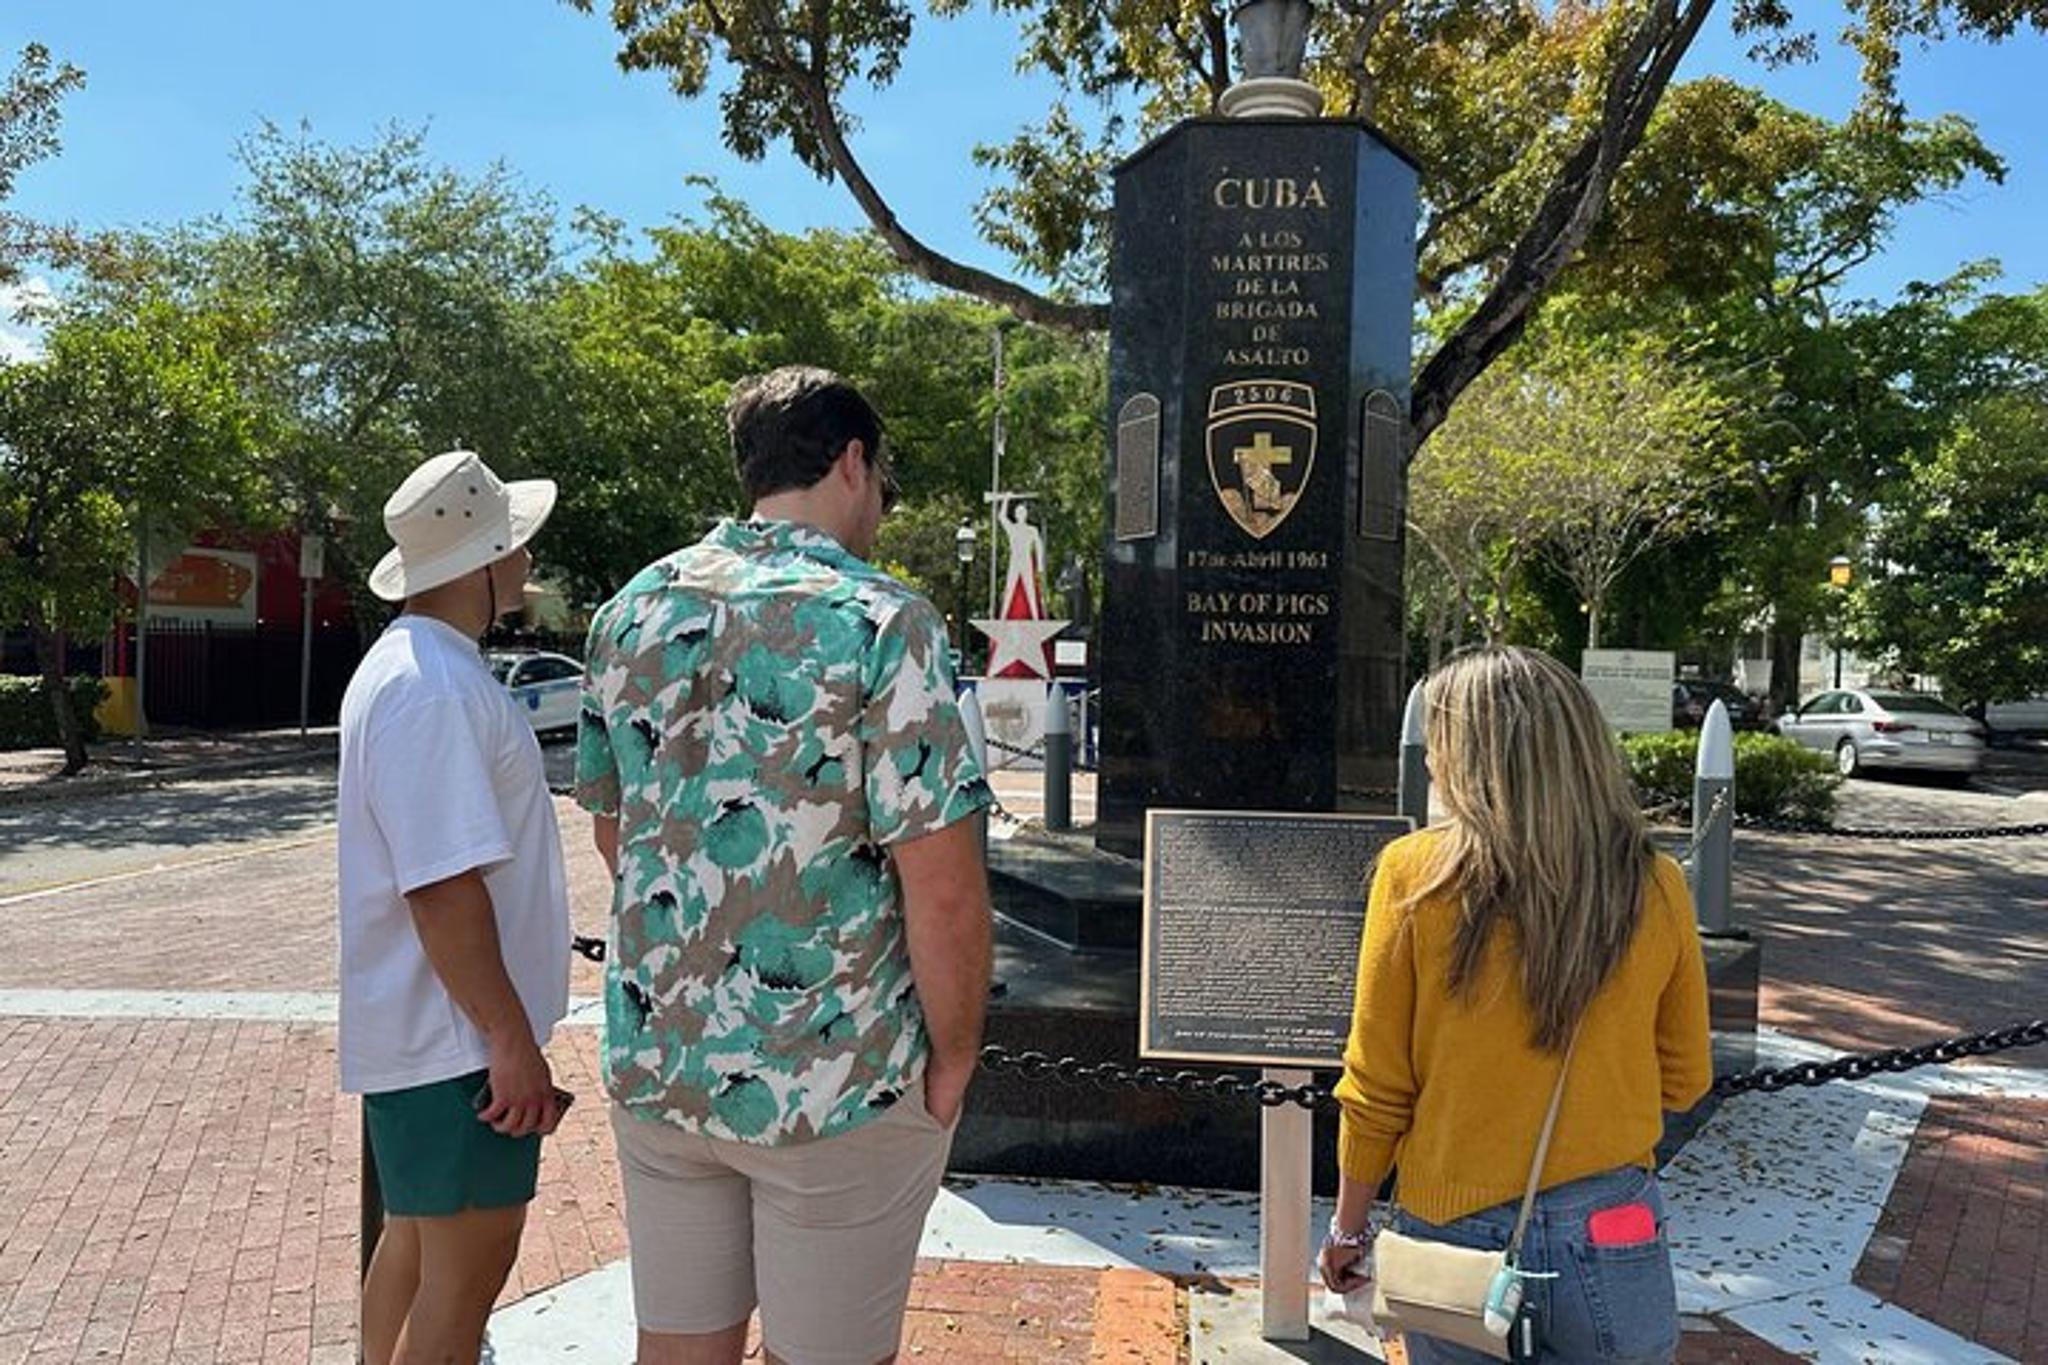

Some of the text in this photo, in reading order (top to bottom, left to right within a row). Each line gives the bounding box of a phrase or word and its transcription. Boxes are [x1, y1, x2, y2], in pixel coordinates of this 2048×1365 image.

[1214, 178, 1327, 208] CUBA
[1238, 232, 1302, 249] A LOS
[1211, 254, 1328, 272] MARTIRES
[1236, 279, 1299, 295] DE LA
[1216, 302, 1318, 320] BRIGADA
[1252, 325, 1281, 342] DE
[1224, 348, 1309, 366] ASALTO
[1233, 386, 1293, 404] 2506
[1286, 551, 1328, 569] 1961
[1187, 593, 1329, 616] BAY OF PIGS
[1202, 621, 1312, 644] INVASION
